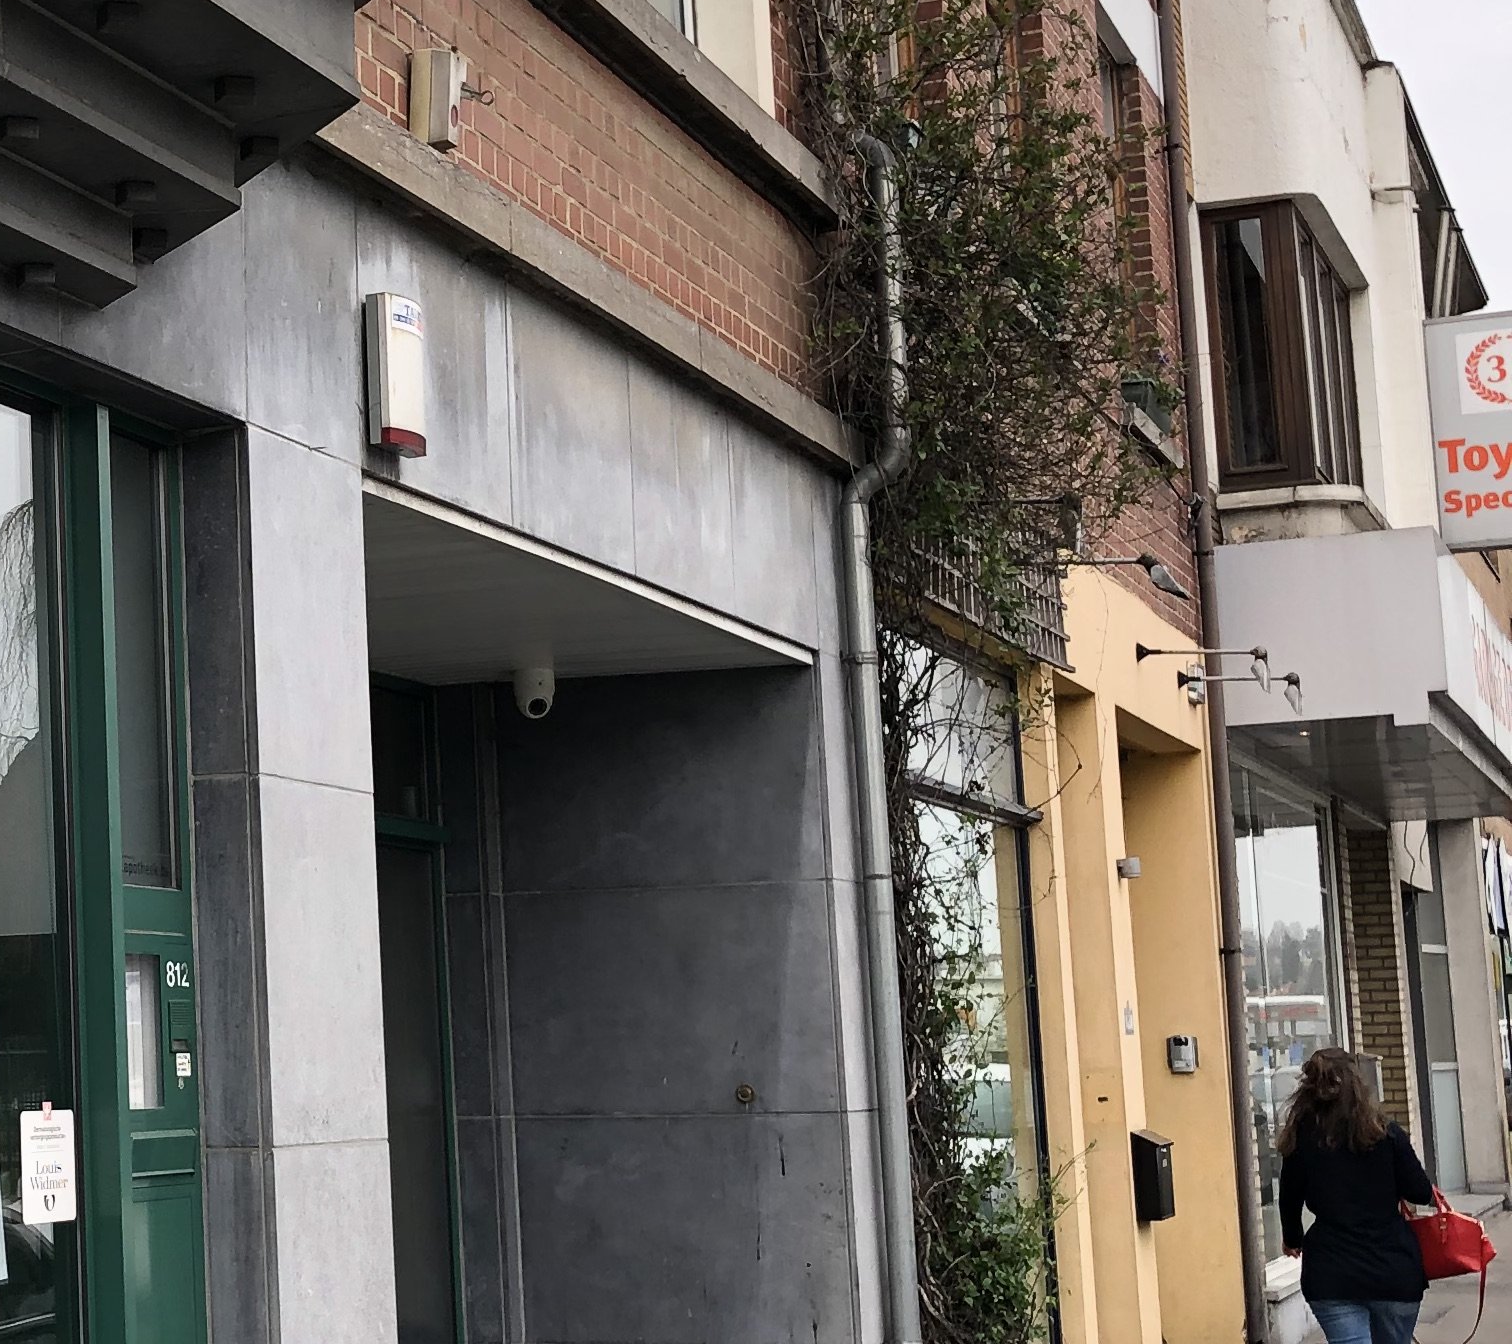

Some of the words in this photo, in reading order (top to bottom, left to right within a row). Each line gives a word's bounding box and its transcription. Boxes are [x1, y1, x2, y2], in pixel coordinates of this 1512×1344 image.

[166, 960, 190, 987] 812
[35, 1160, 63, 1175] Louis
[30, 1176, 69, 1191] Widmer
